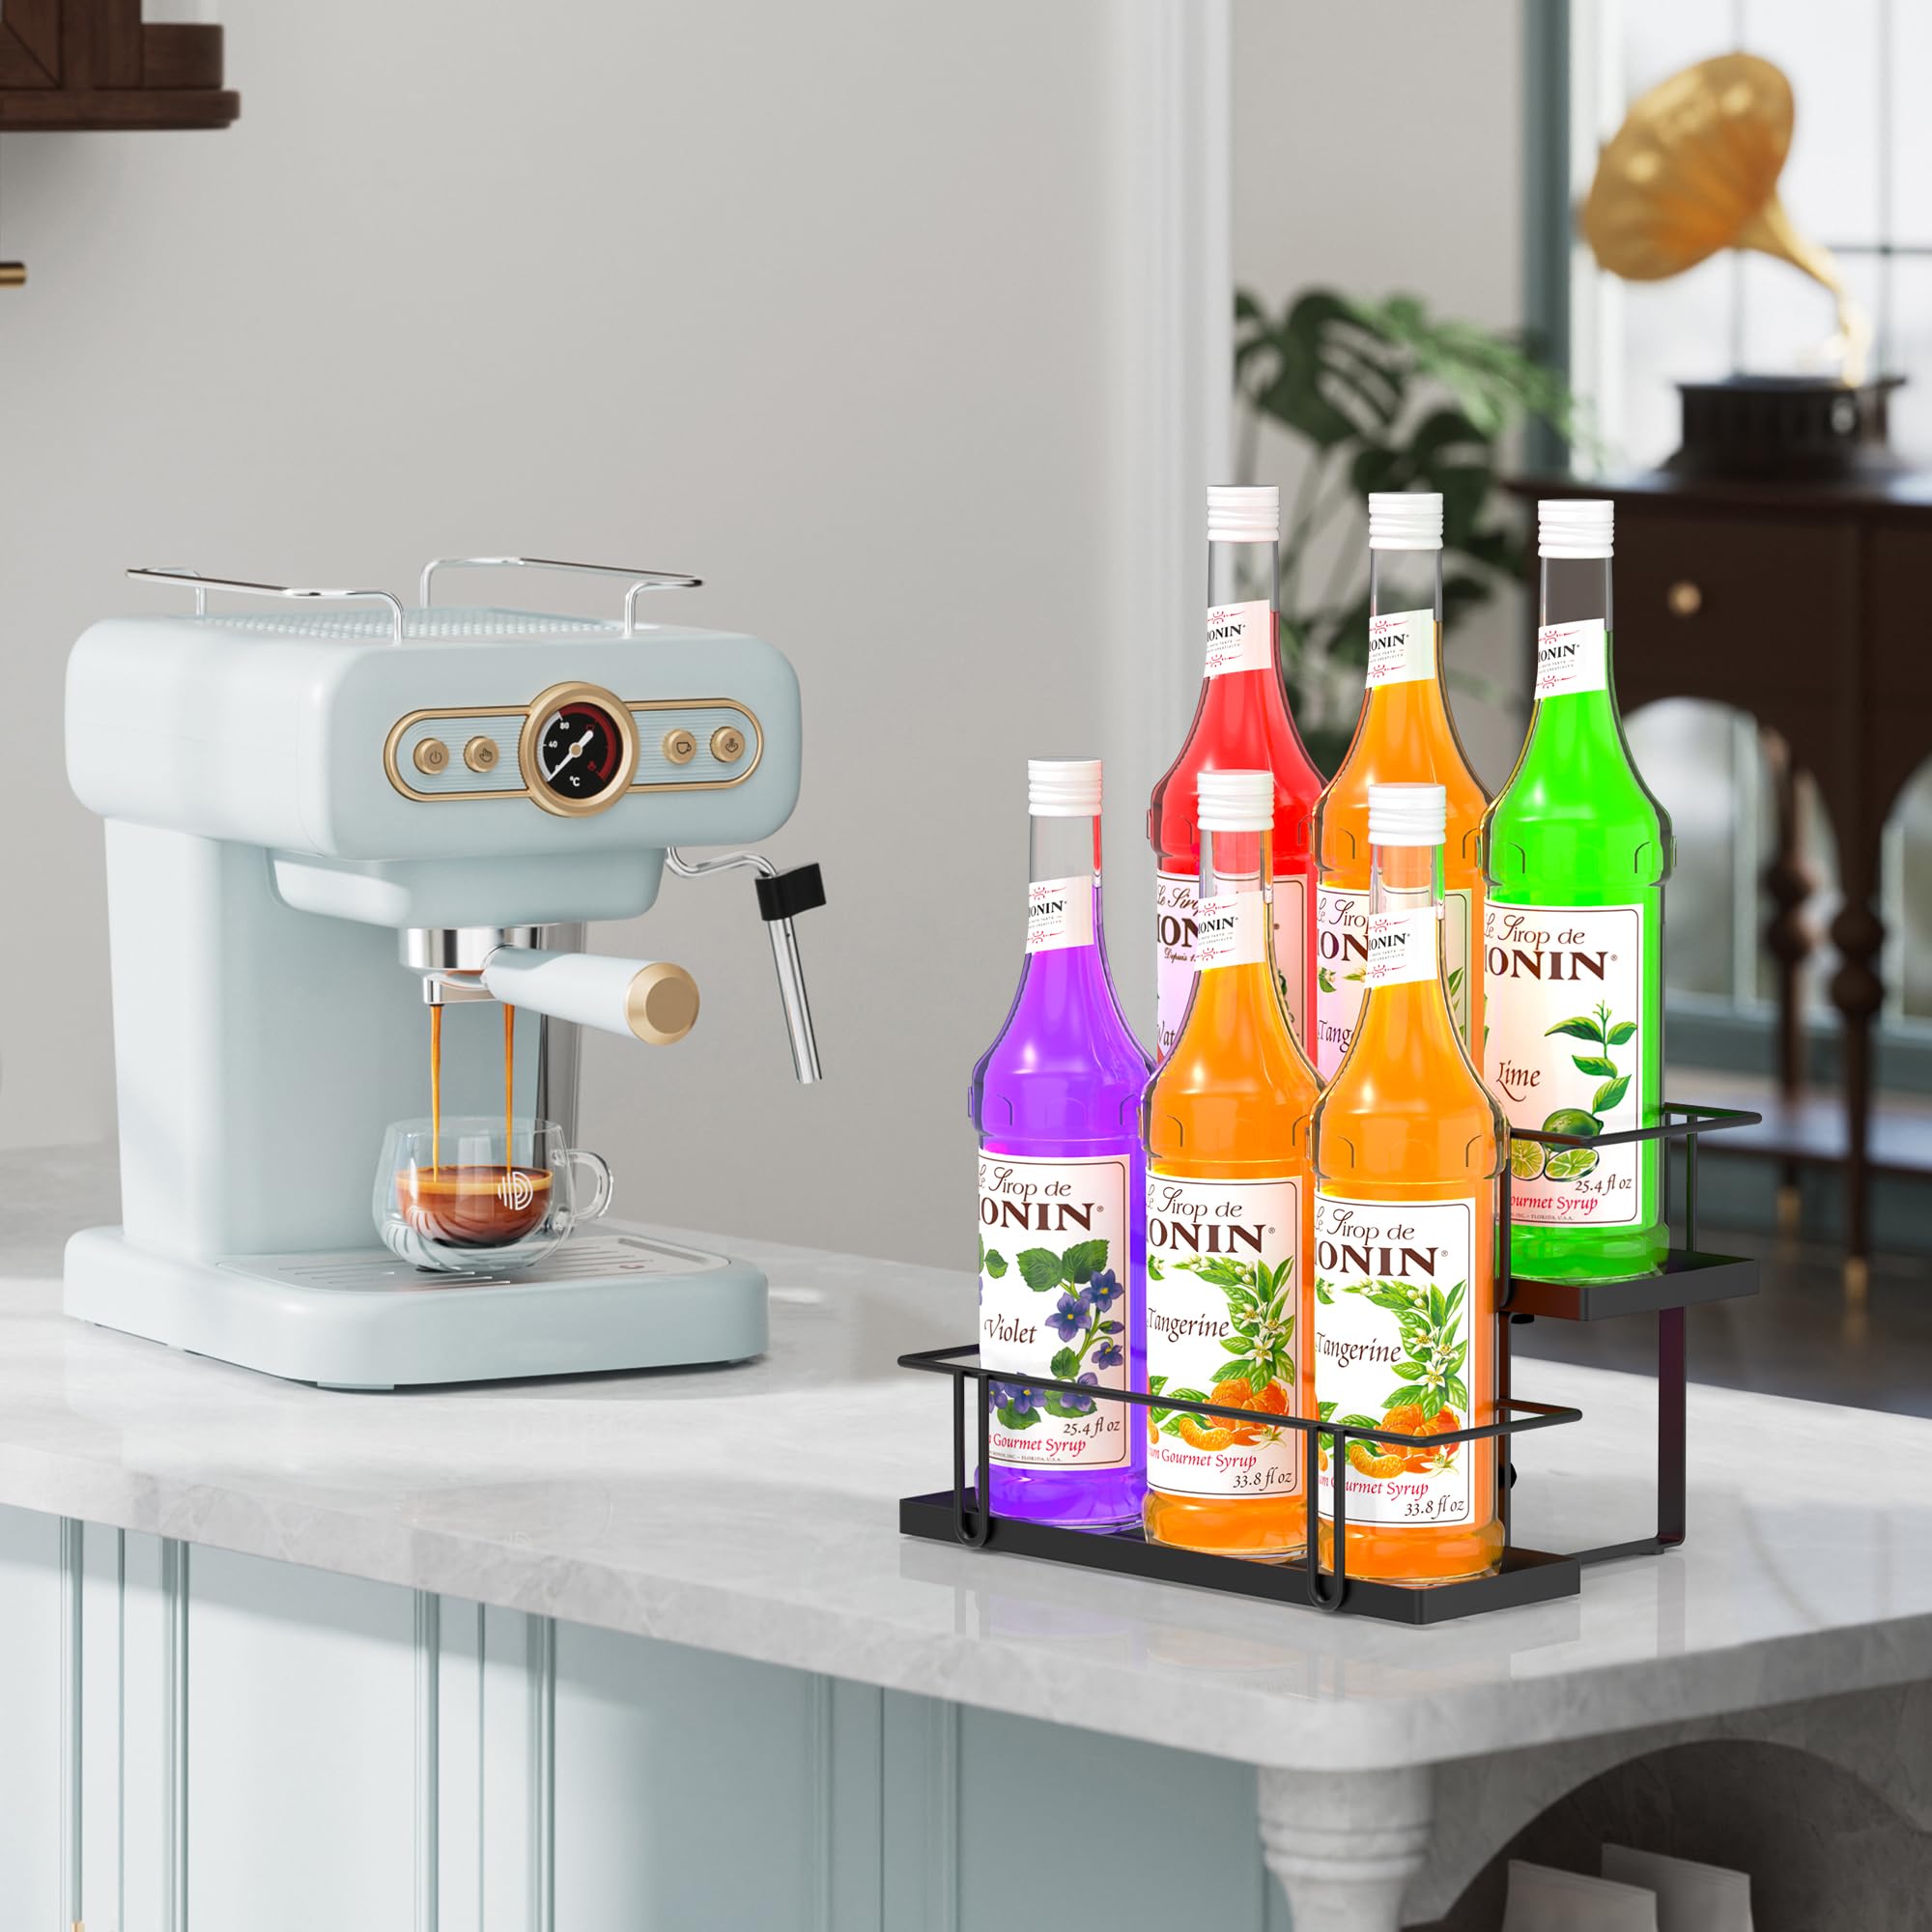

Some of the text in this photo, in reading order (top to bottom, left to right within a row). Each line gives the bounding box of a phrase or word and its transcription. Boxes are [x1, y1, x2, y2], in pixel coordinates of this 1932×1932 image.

[1208, 624, 1242, 641] ONIN
[1369, 634, 1406, 652] ONIN
[1538, 643, 1577, 663] ONIN
[1029, 900, 1064, 918] ONIN
[1198, 917, 1235, 934] ONIN
[1497, 914, 1550, 951] Sirop
[1557, 928, 1585, 945] de
[1369, 933, 1406, 951] ONIN
[1485, 944, 1609, 980] ONIN
[1496, 1060, 1541, 1102] Lime
[988, 1167, 1037, 1202] Sirop
[1044, 1181, 1071, 1196] de
[1575, 1174, 1633, 1196] 25.4 fl oz
[979, 1194, 1095, 1231] ONIN
[1157, 1186, 1208, 1223] Sirop
[1215, 1202, 1242, 1217] de
[1511, 1196, 1598, 1216] ourmet Syrup
[1147, 1215, 1266, 1254] ONIN
[1327, 1208, 1379, 1245] Sirop
[1387, 1224, 1415, 1240] de
[1315, 1237, 1439, 1276] ONIN
[984, 1314, 1037, 1344] Violet
[1147, 1307, 1230, 1343] Tangerine
[1316, 1331, 1402, 1368] Tangerine
[1064, 1416, 1121, 1438] 25.4 fl oz
[993, 1434, 1042, 1450] Gourmet
[1045, 1437, 1086, 1457] Syrup
[1161, 1448, 1211, 1466] Gourmet
[1215, 1454, 1257, 1473] Syrup
[1234, 1466, 1293, 1492] 33.8 fl oz
[1386, 1482, 1429, 1502] Syrup
[1405, 1494, 1465, 1520] 33.8 fl oz
